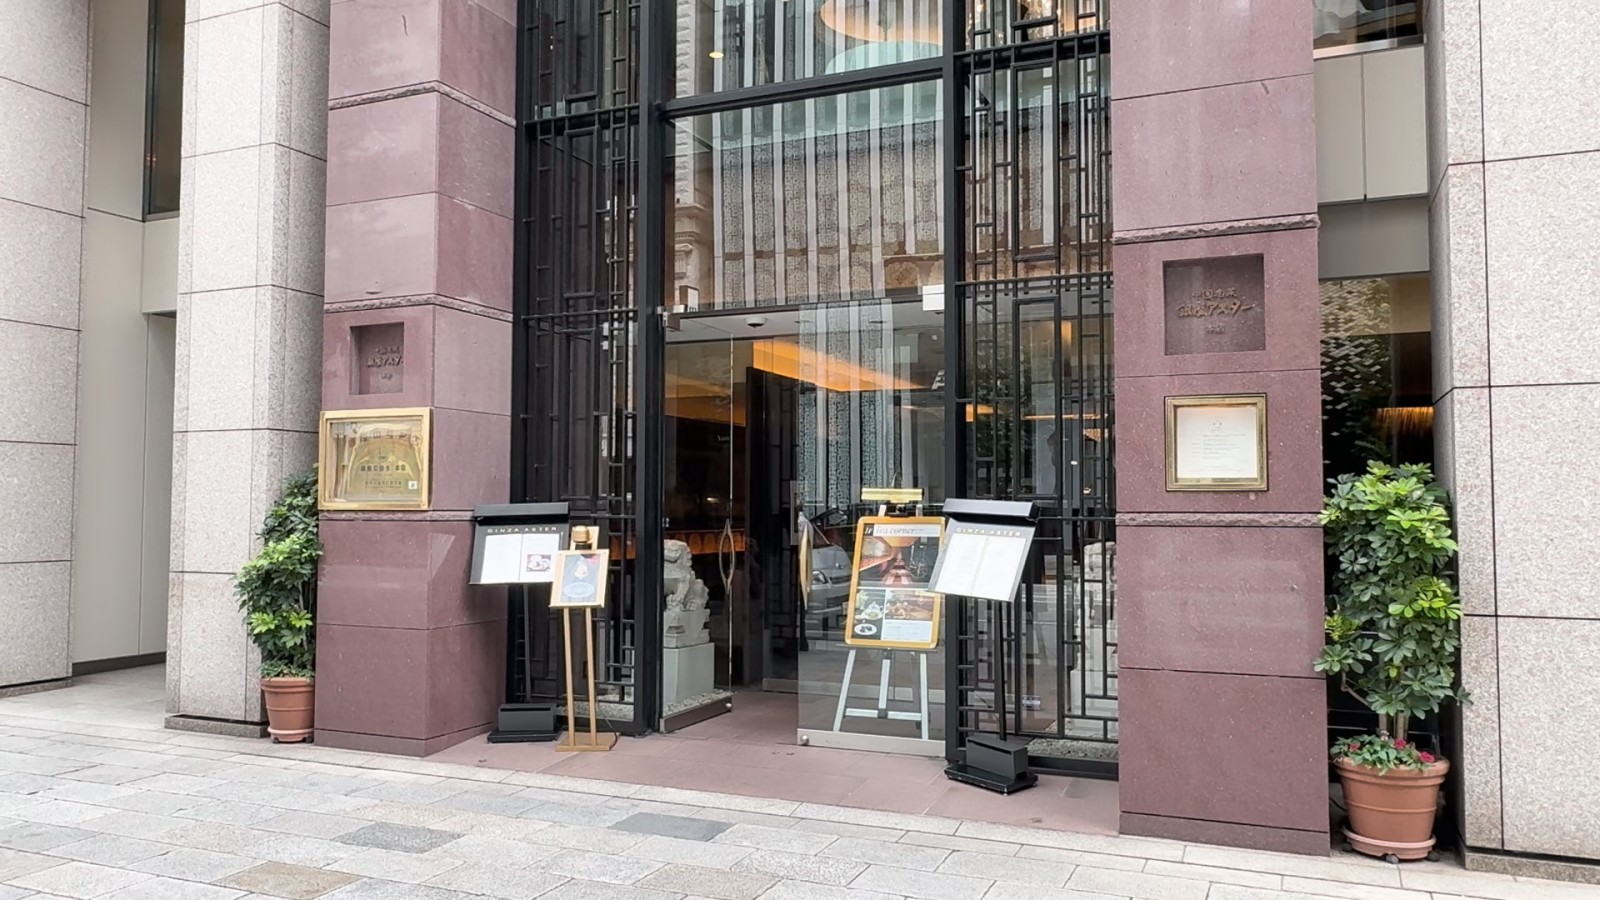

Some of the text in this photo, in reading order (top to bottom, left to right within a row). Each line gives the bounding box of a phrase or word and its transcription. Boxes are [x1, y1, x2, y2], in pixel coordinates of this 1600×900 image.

[889, 527, 916, 535] corner
[956, 527, 1021, 537] GINZA ASTER
